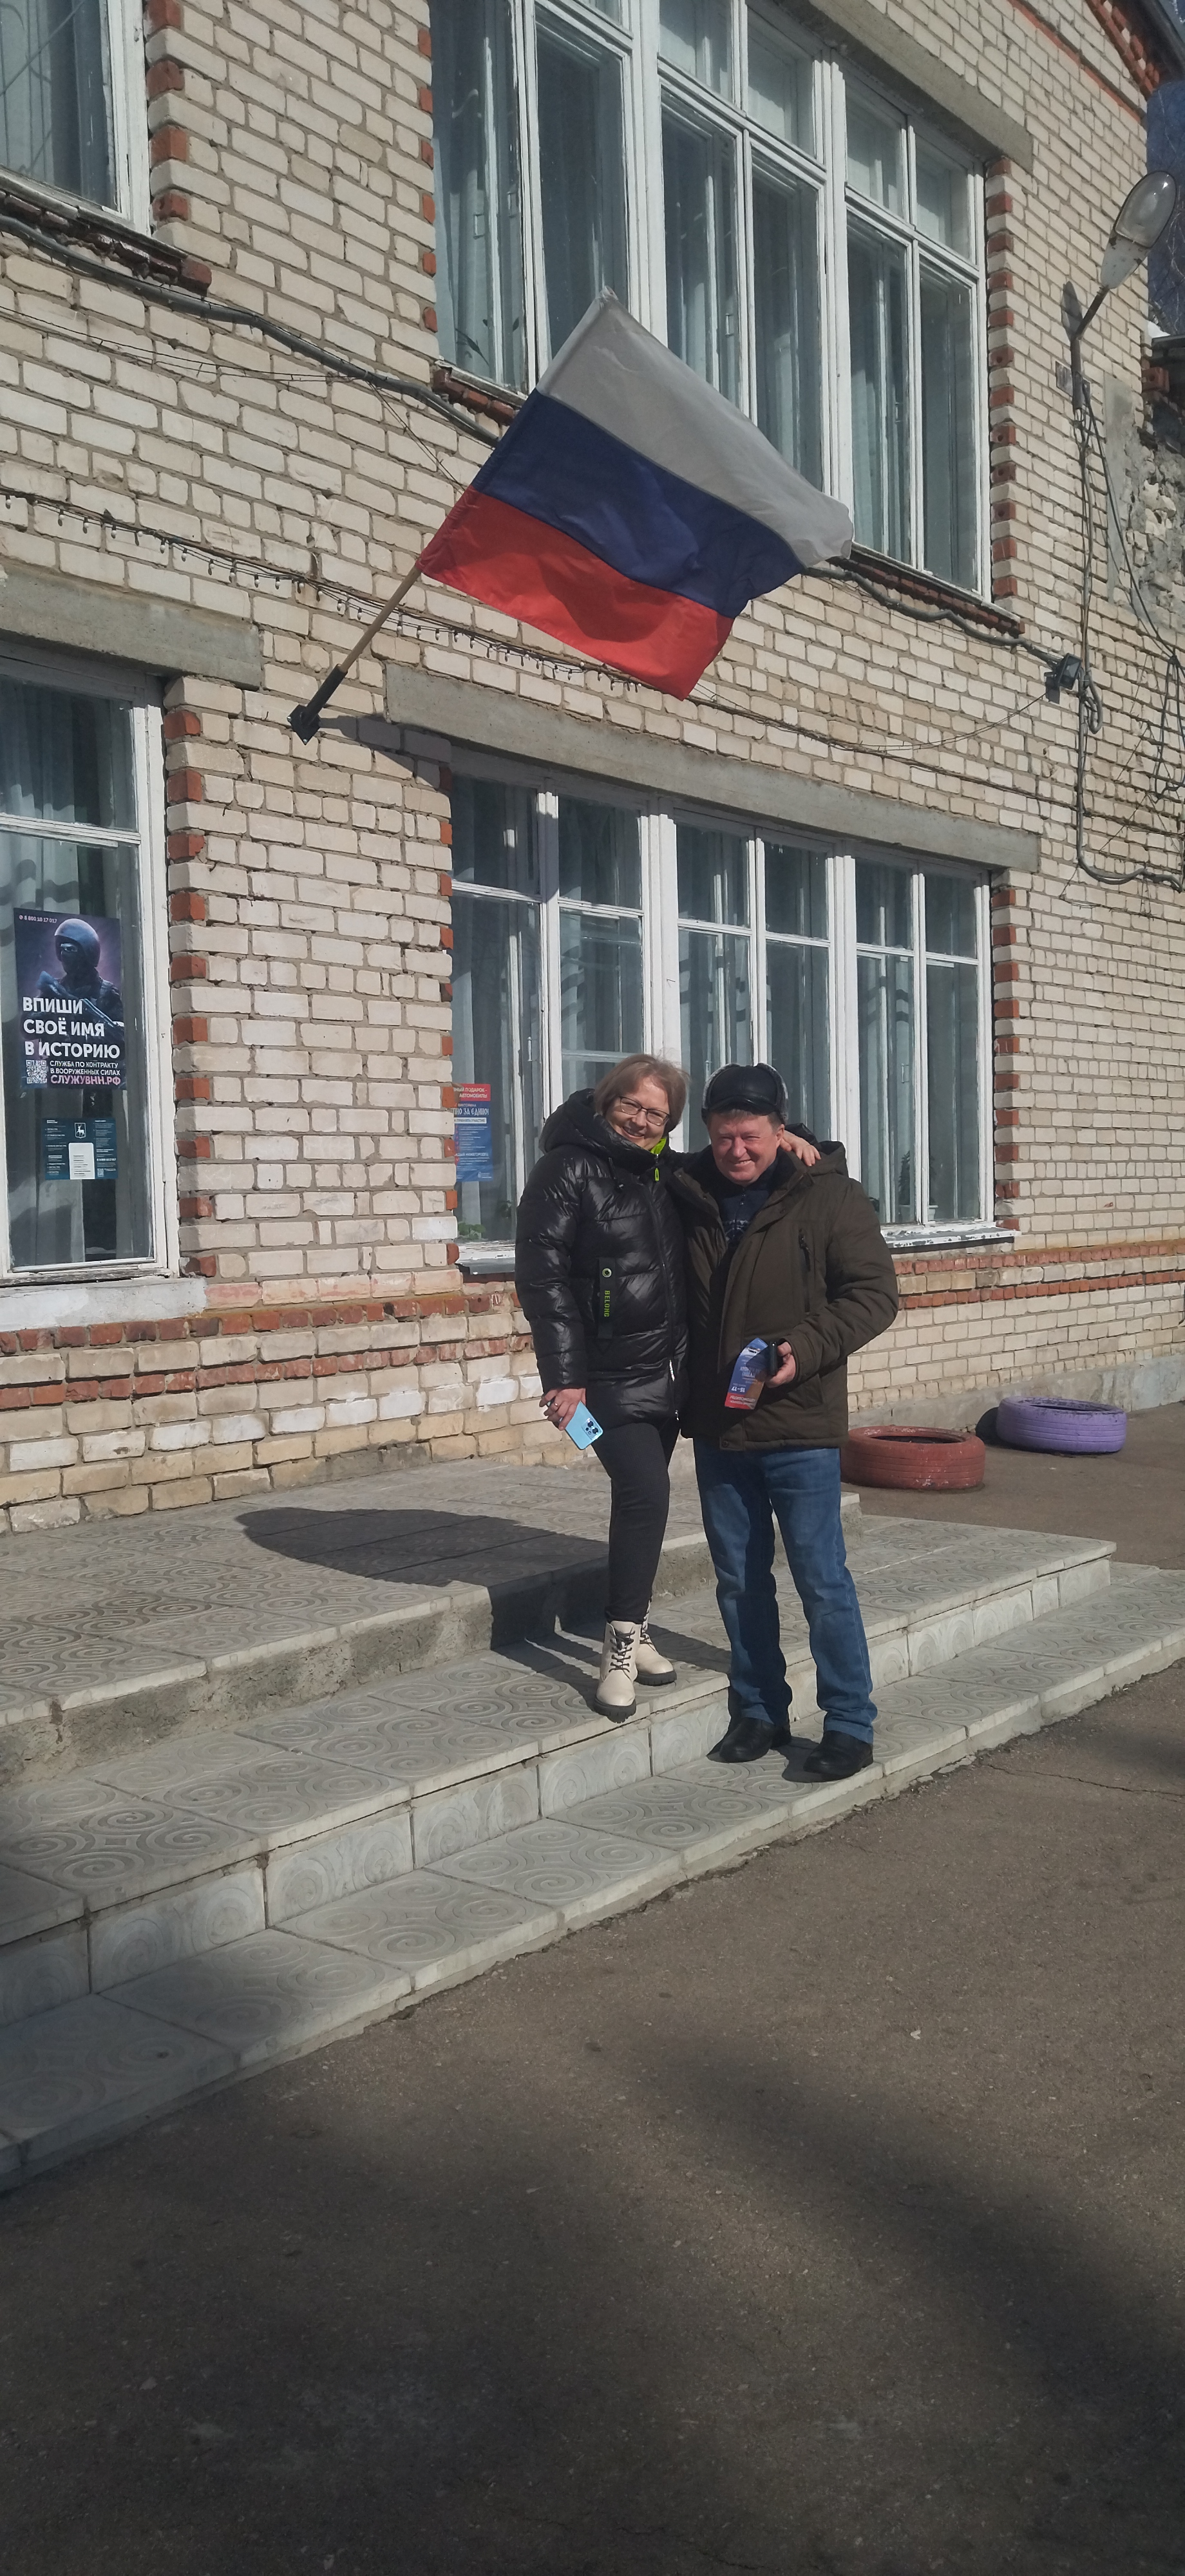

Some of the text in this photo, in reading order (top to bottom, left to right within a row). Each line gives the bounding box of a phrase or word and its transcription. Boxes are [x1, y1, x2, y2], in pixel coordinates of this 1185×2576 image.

[23, 996, 82, 1014] ВПИШИ
[23, 1017, 105, 1037] СВОЁ ИМЯ
[24, 1041, 120, 1059] В ИСТОРИЮ
[50, 1074, 121, 1086] СЛУЖУВНН.РФ
